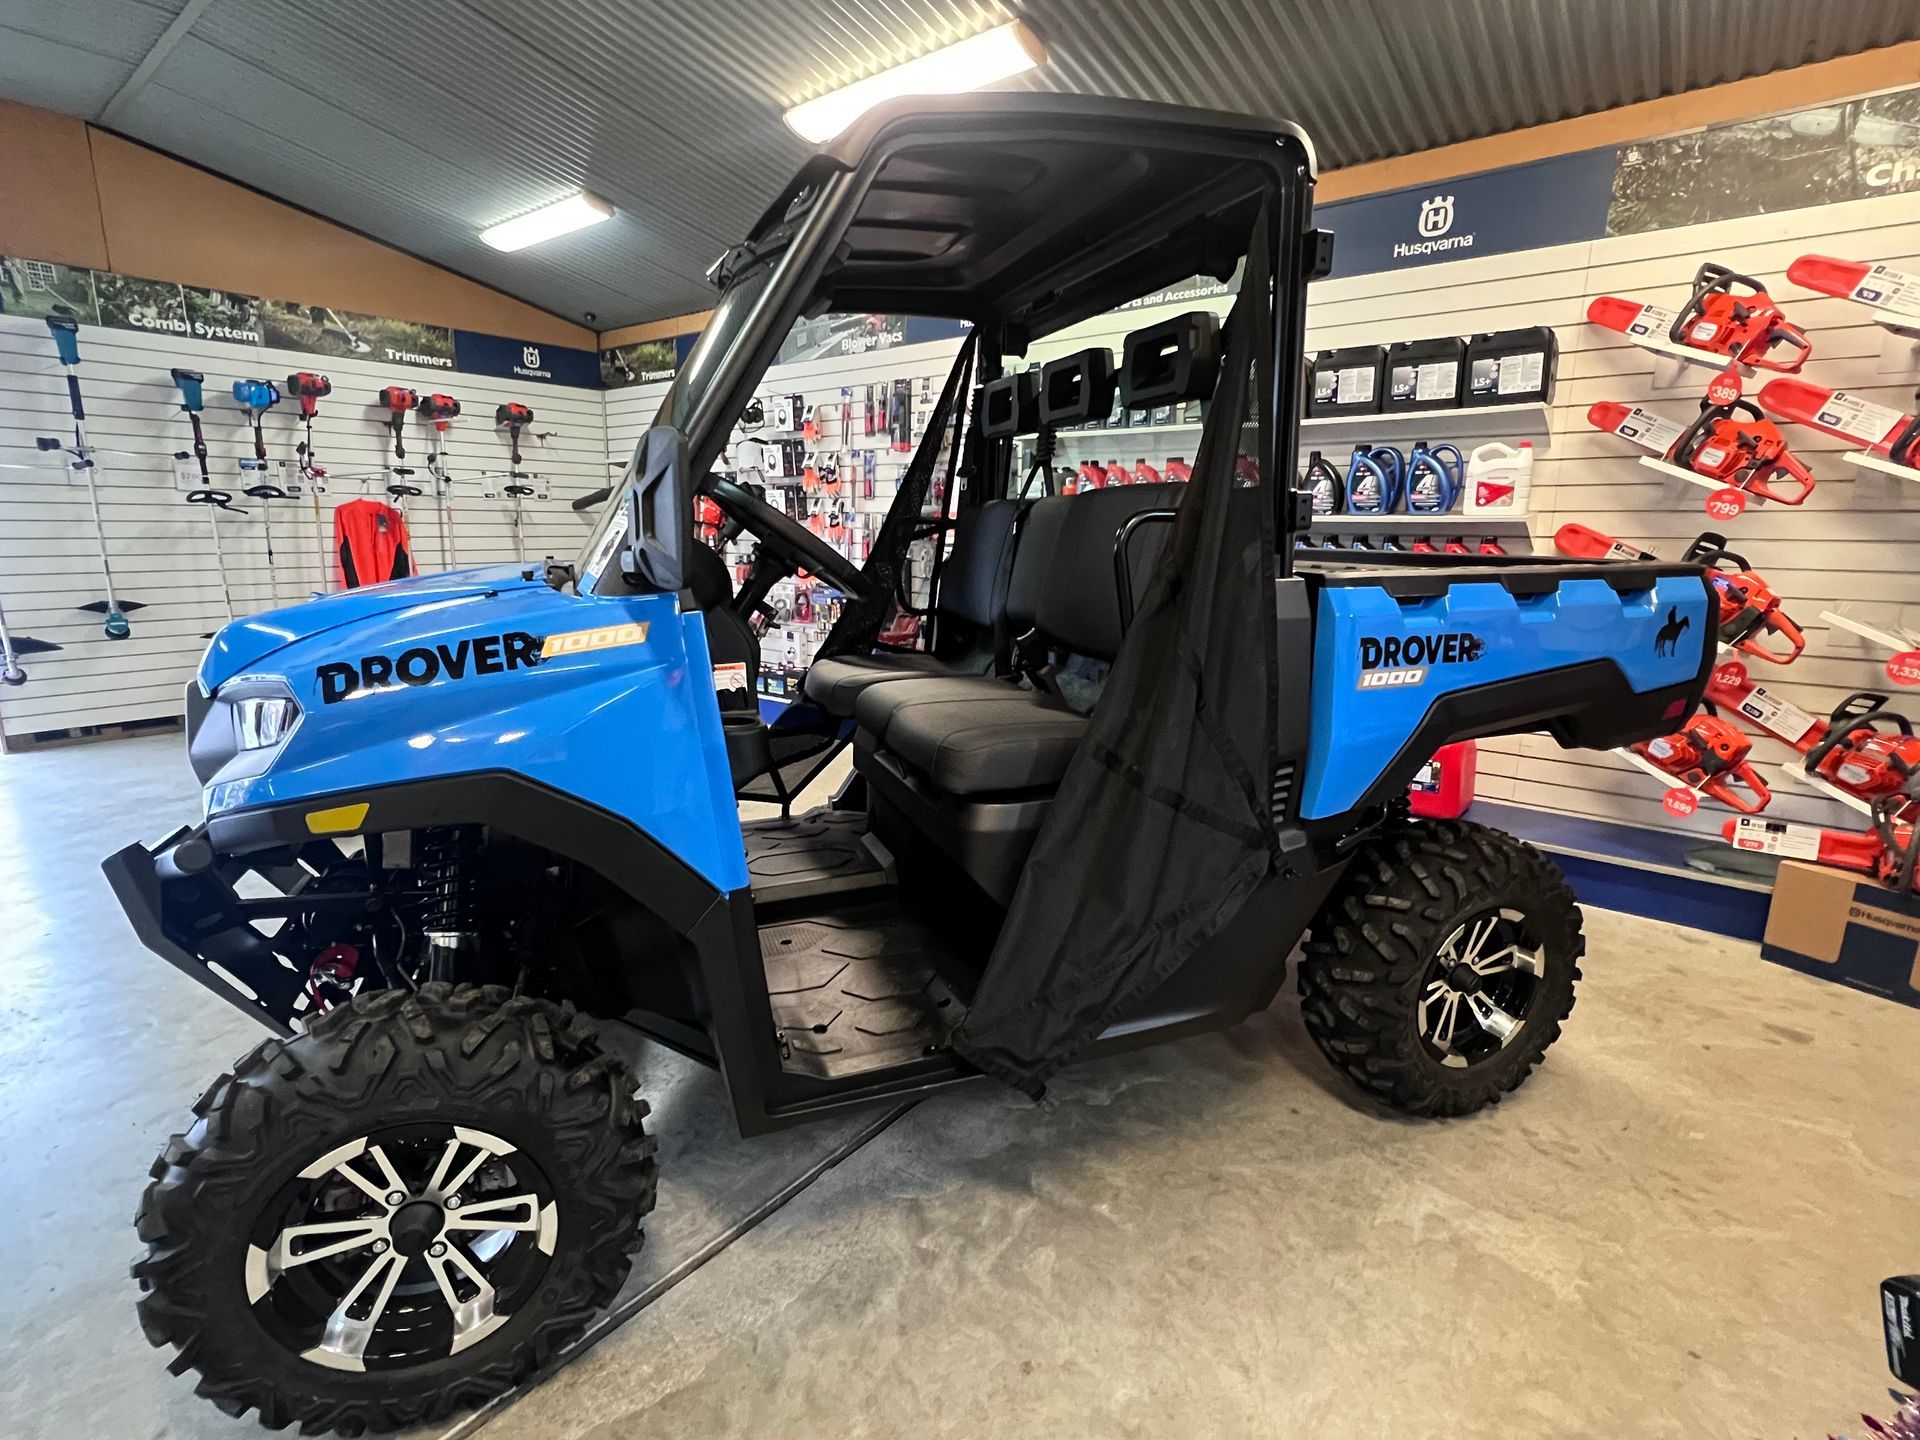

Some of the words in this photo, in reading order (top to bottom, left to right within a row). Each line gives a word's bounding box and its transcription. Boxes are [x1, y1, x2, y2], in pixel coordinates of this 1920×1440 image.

[1866, 161, 1920, 186] Ch
[1394, 234, 1474, 257] Husqvarna
[1143, 293, 1164, 306] and
[1164, 283, 1229, 302] Accessories
[128, 313, 191, 335] Combi
[195, 322, 259, 343] System
[841, 335, 878, 351] Blower
[385, 348, 453, 368] Trimmers
[513, 365, 552, 378] Husqvarna
[641, 369, 676, 381] Trimmers
[1359, 632, 1477, 670] DROVER
[317, 632, 541, 704] DROVER
[550, 624, 643, 651] 1000
[1362, 669, 1423, 688] 1000
